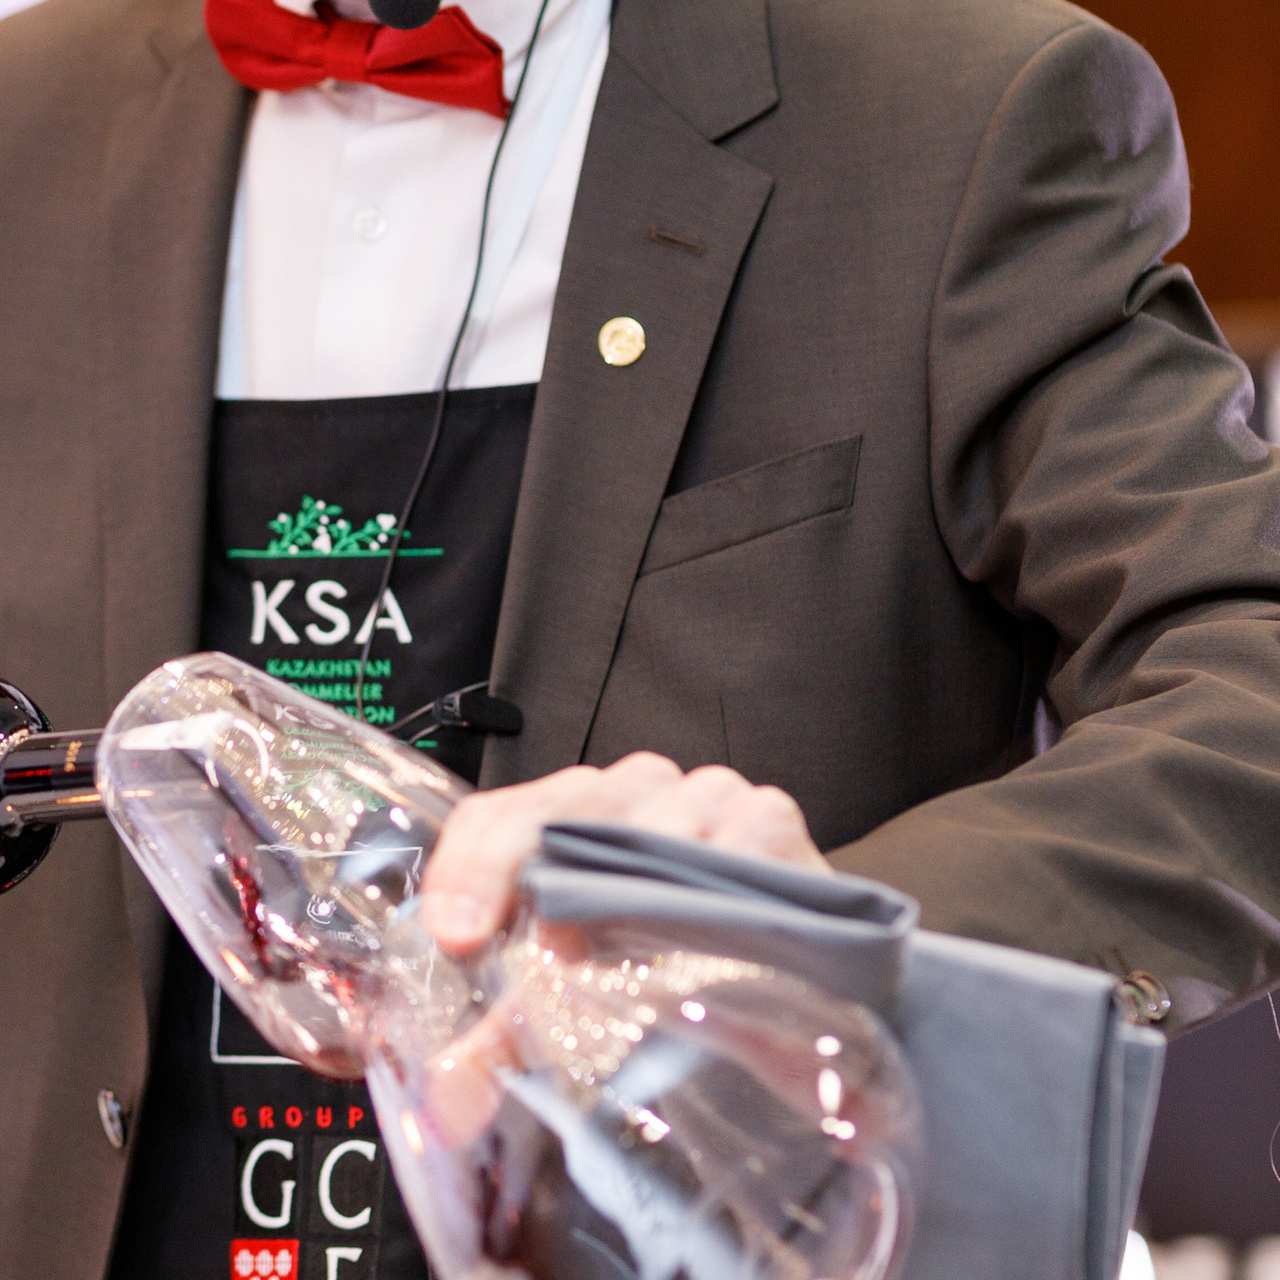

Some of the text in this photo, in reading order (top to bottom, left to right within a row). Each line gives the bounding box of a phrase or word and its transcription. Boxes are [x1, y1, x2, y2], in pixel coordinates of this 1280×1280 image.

[250, 578, 413, 645] KSA
[265, 658, 392, 679] KAZAKHSTAN
[287, 682, 383, 701] MMELIER
[231, 1105, 382, 1129] GROUP
